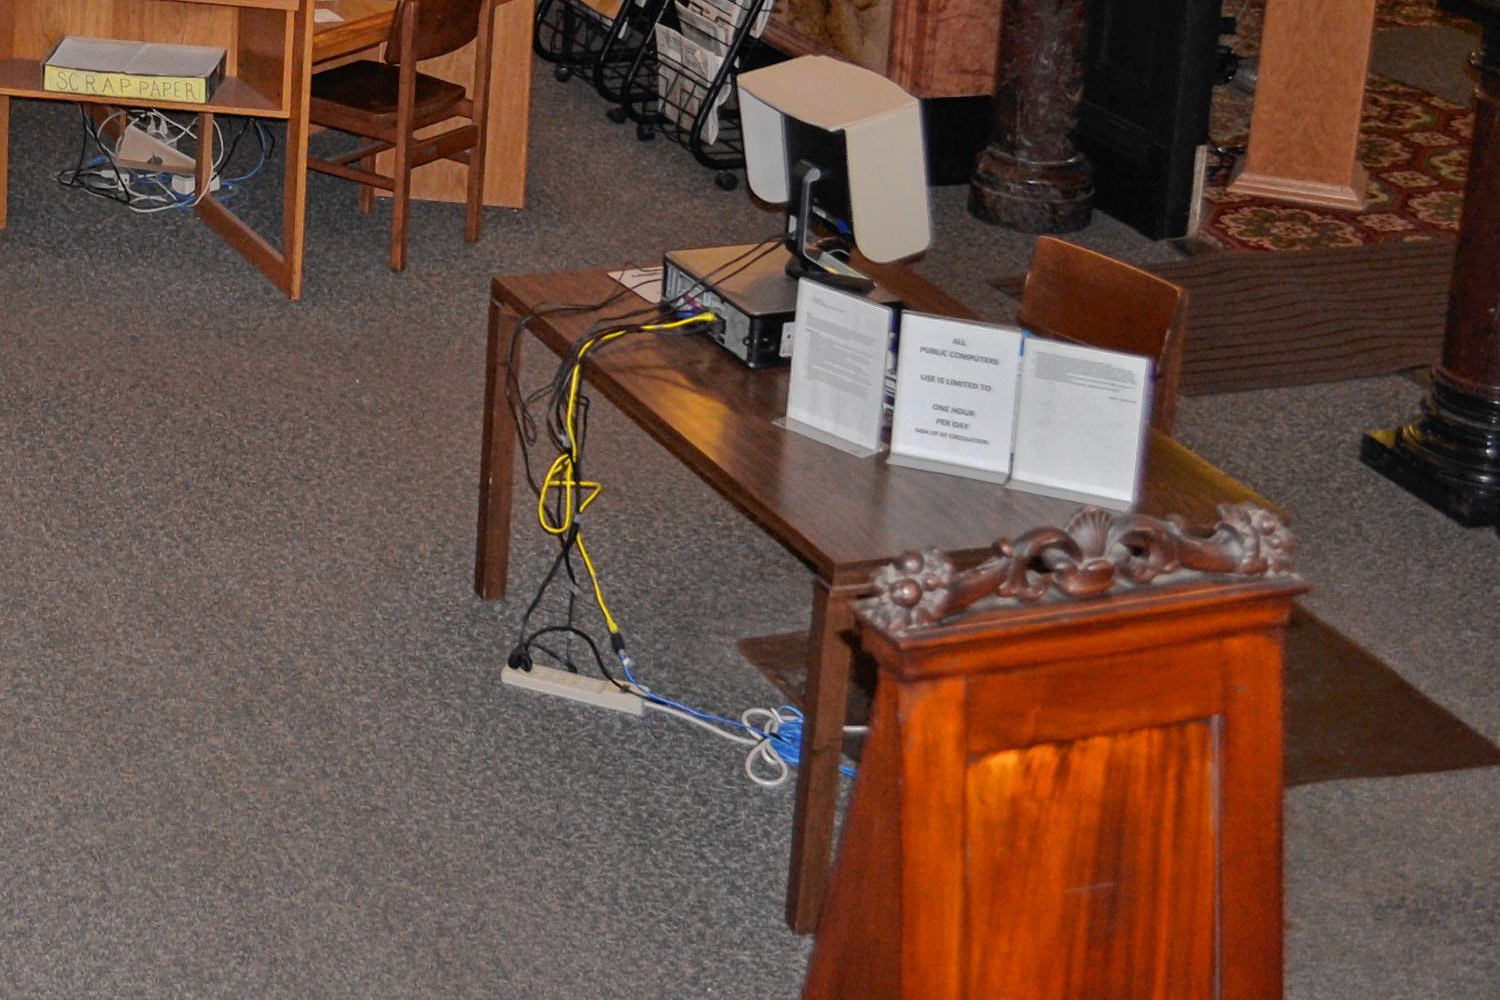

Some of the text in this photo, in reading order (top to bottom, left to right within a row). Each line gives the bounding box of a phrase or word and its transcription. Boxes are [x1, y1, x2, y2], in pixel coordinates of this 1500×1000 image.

[56, 71, 198, 99] SCRAP PAPER
[952, 338, 967, 347] ALL
[920, 346, 999, 365] PUBLIC COMPUTERS
[920, 374, 992, 392] USE IS LIMITED TO
[932, 403, 975, 417] ONE HOUR
[936, 418, 970, 430] PER DAY
